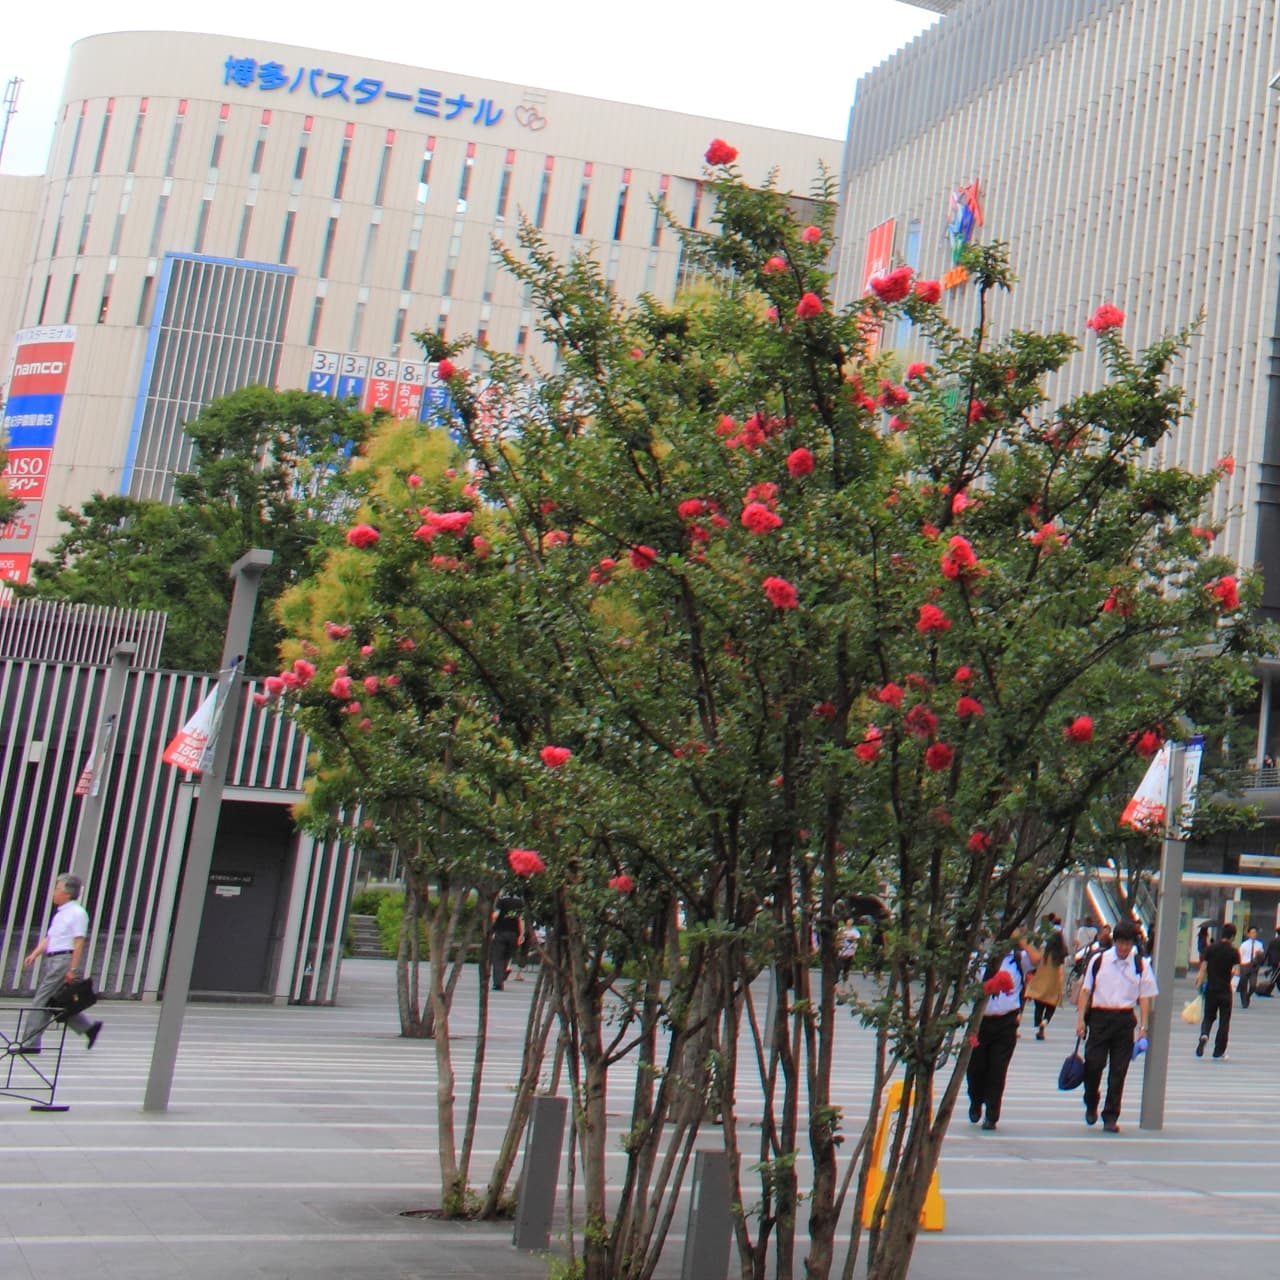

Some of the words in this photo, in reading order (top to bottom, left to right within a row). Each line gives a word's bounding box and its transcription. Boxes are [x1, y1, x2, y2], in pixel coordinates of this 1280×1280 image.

[224, 56, 503, 126] 博多バスターミナル
[15, 361, 64, 376] namco
[315, 353, 334, 370] 3F
[345, 357, 363, 374] 3F
[375, 361, 393, 377] 8F
[403, 365, 421, 381] 8F
[4, 457, 43, 475] AISO
